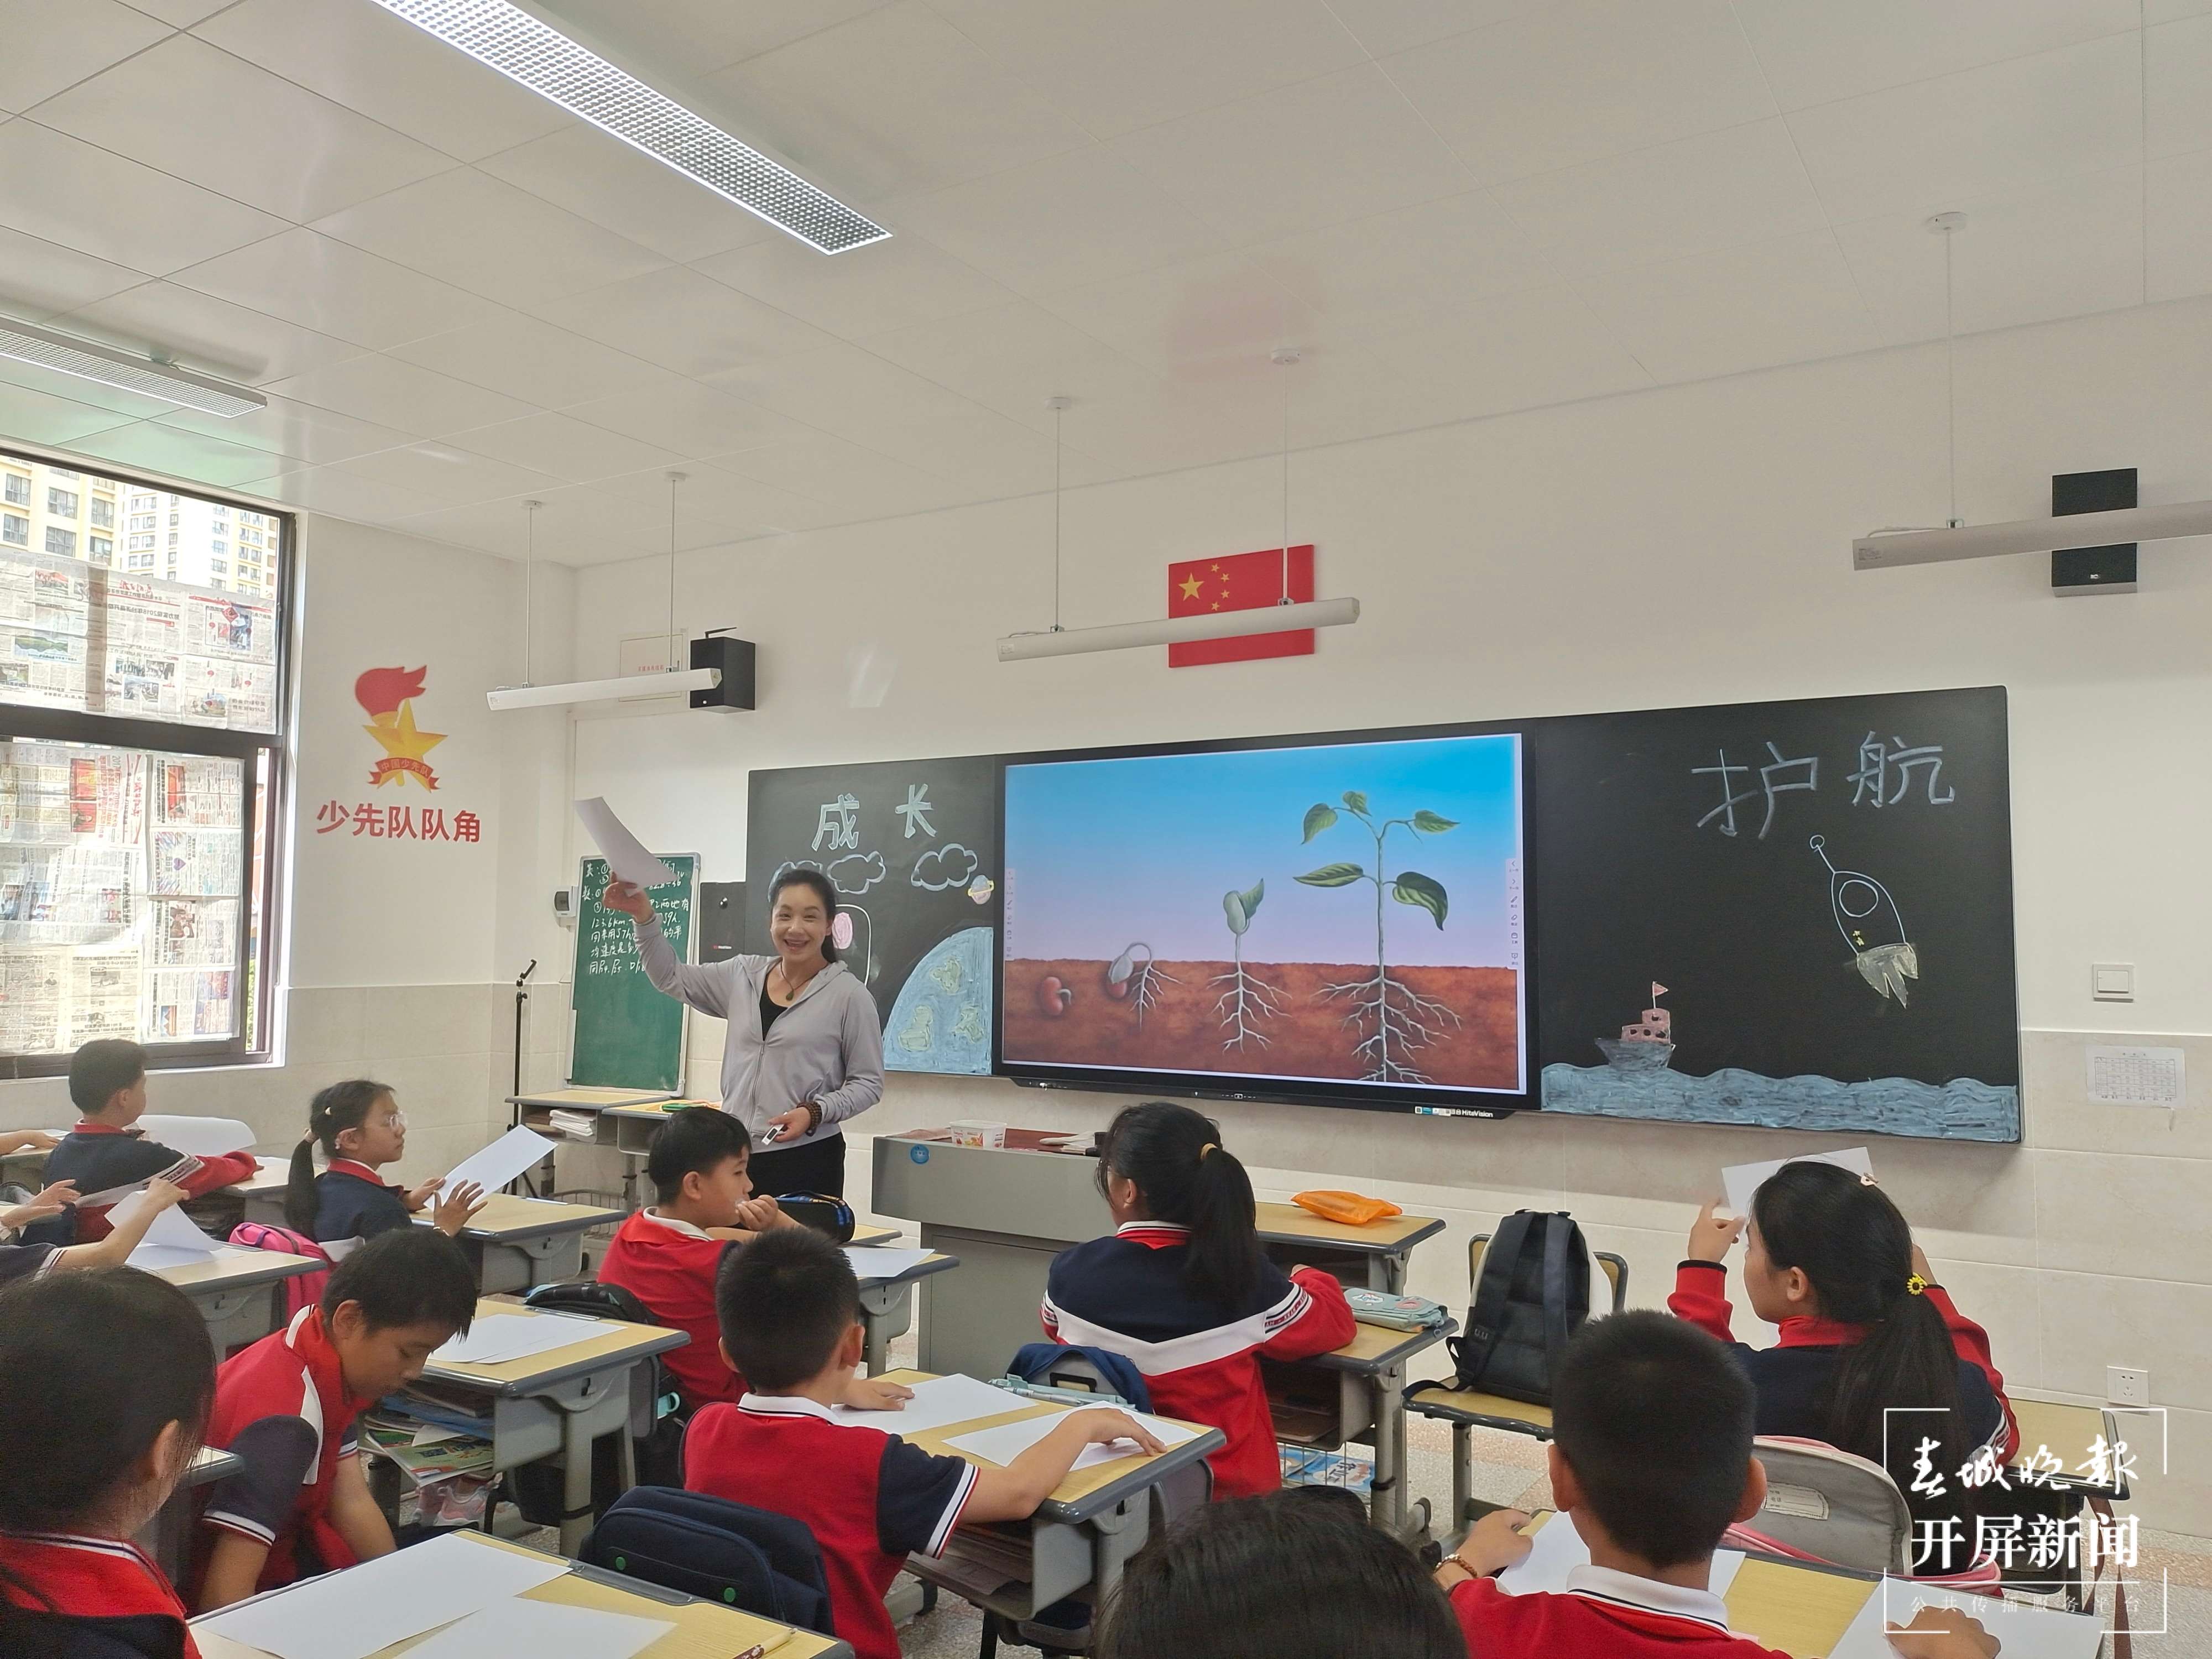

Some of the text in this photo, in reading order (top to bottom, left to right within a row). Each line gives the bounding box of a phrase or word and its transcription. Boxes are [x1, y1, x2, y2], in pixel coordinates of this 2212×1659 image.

[381, 759, 430, 777] 中国少先队
[1691, 731, 1956, 840] 护航
[316, 800, 481, 843] 少先队队角
[811, 783, 937, 852] 成长
